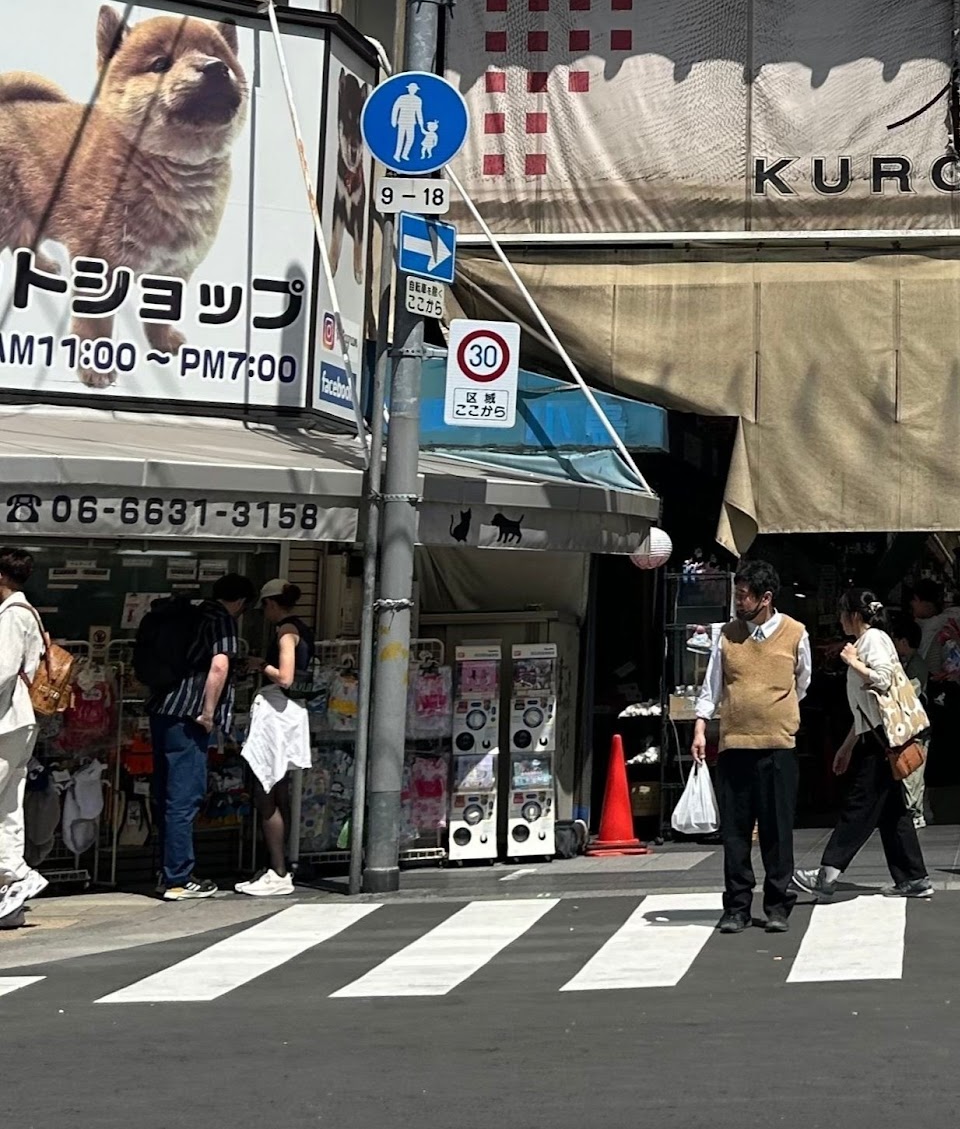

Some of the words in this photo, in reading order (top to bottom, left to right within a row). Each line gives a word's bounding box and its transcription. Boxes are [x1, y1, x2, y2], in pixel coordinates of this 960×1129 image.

[13, 251, 305, 329] トショップ
[408, 294, 443, 315] ここから
[469, 344, 497, 368] 30
[466, 392, 496, 404] 区域
[455, 404, 506, 418] ここから
[52, 495, 318, 530] 06-6631-3158
